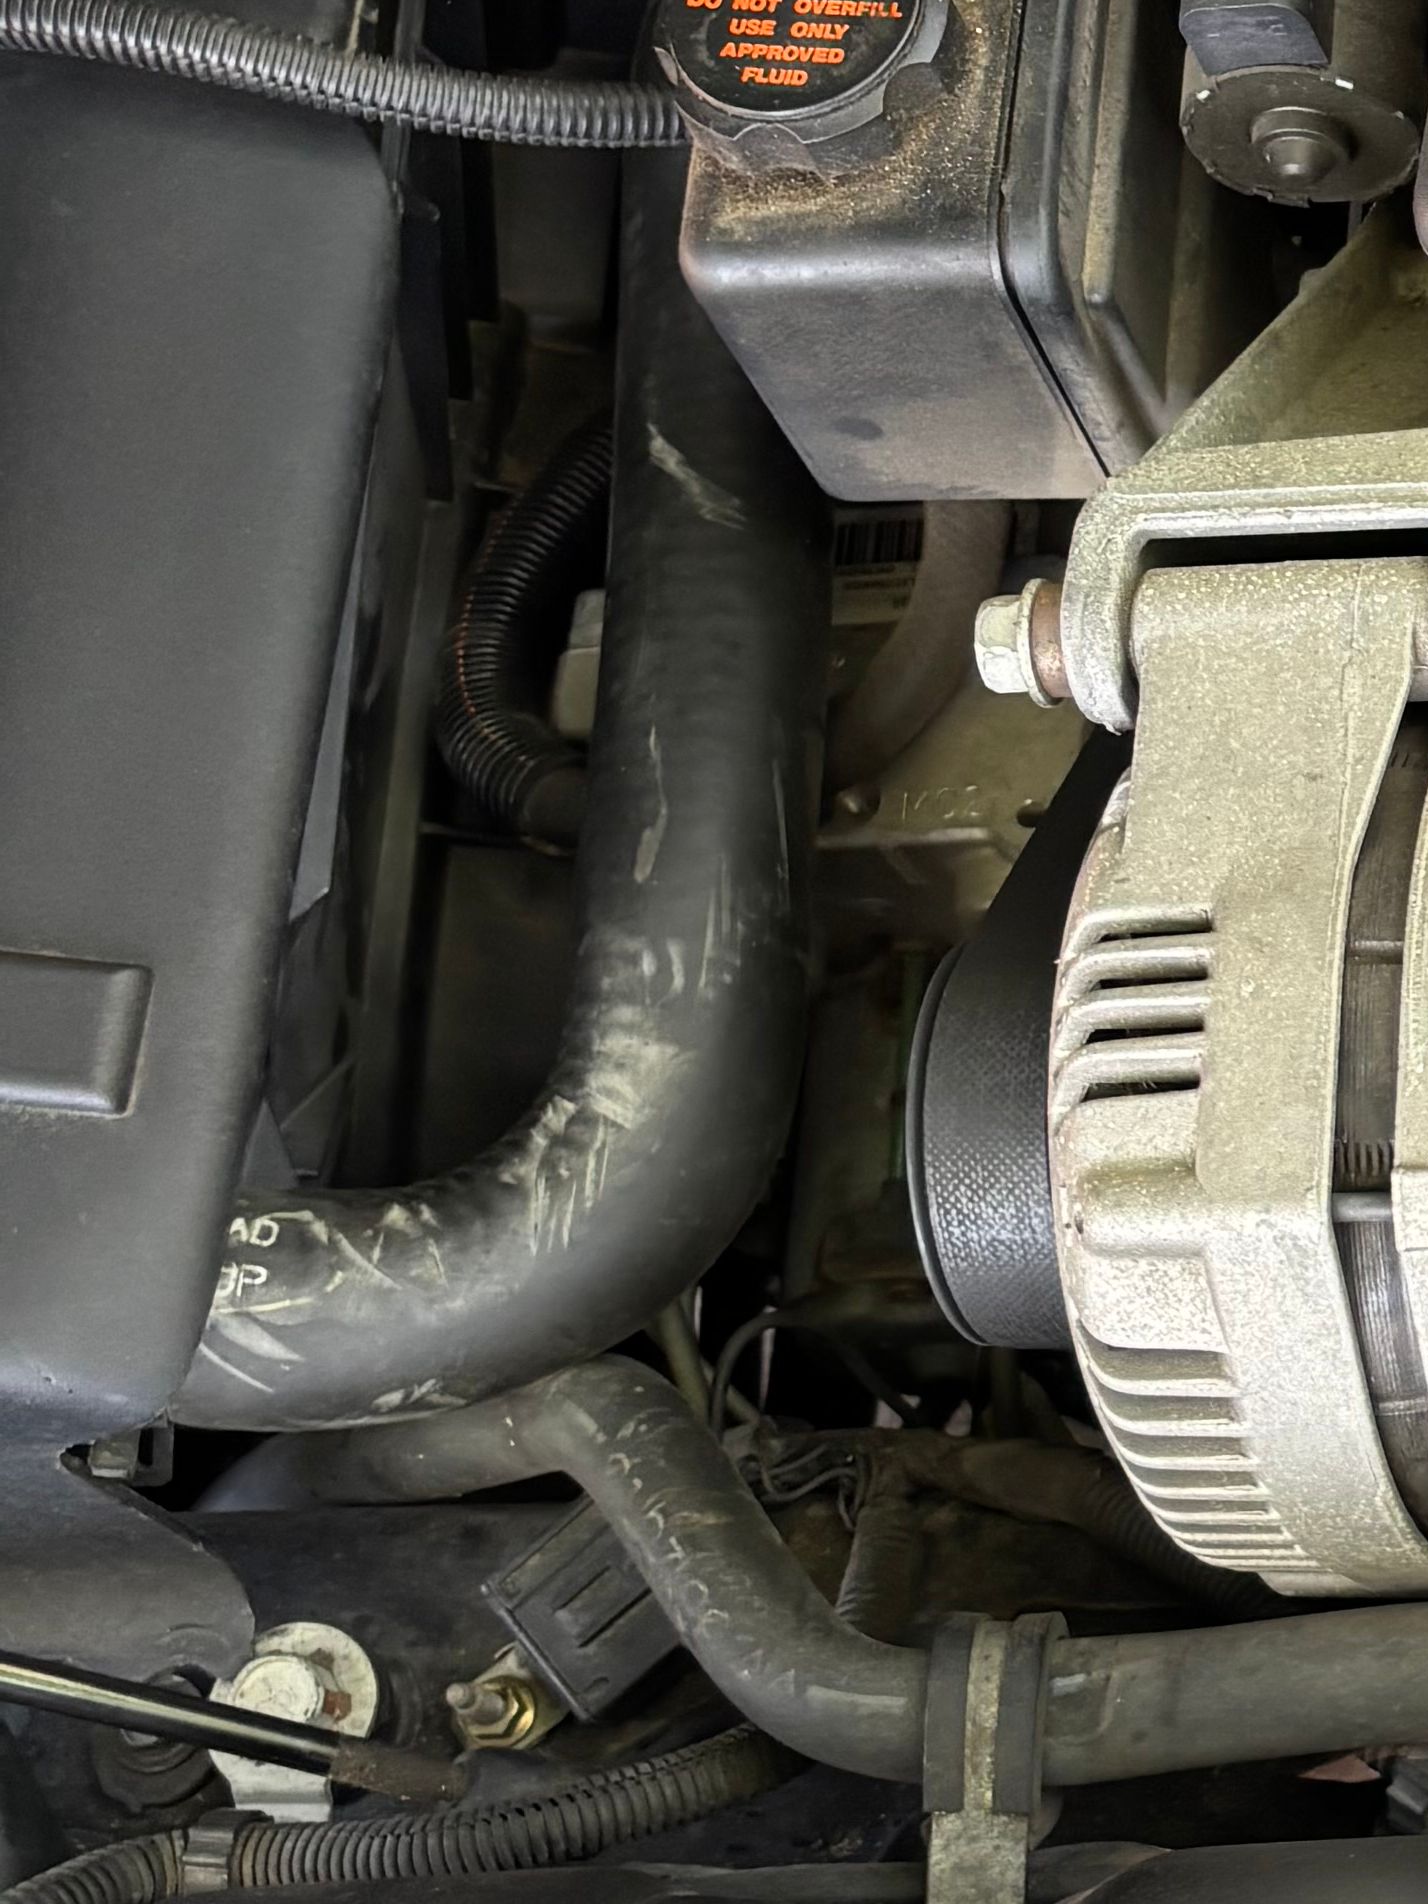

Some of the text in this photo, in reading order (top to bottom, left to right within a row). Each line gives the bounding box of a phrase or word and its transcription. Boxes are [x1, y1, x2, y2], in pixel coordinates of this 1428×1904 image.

[729, 18, 850, 40] USE ONLY
[719, 42, 845, 64] APPROVED
[740, 67, 808, 87] FLUID
